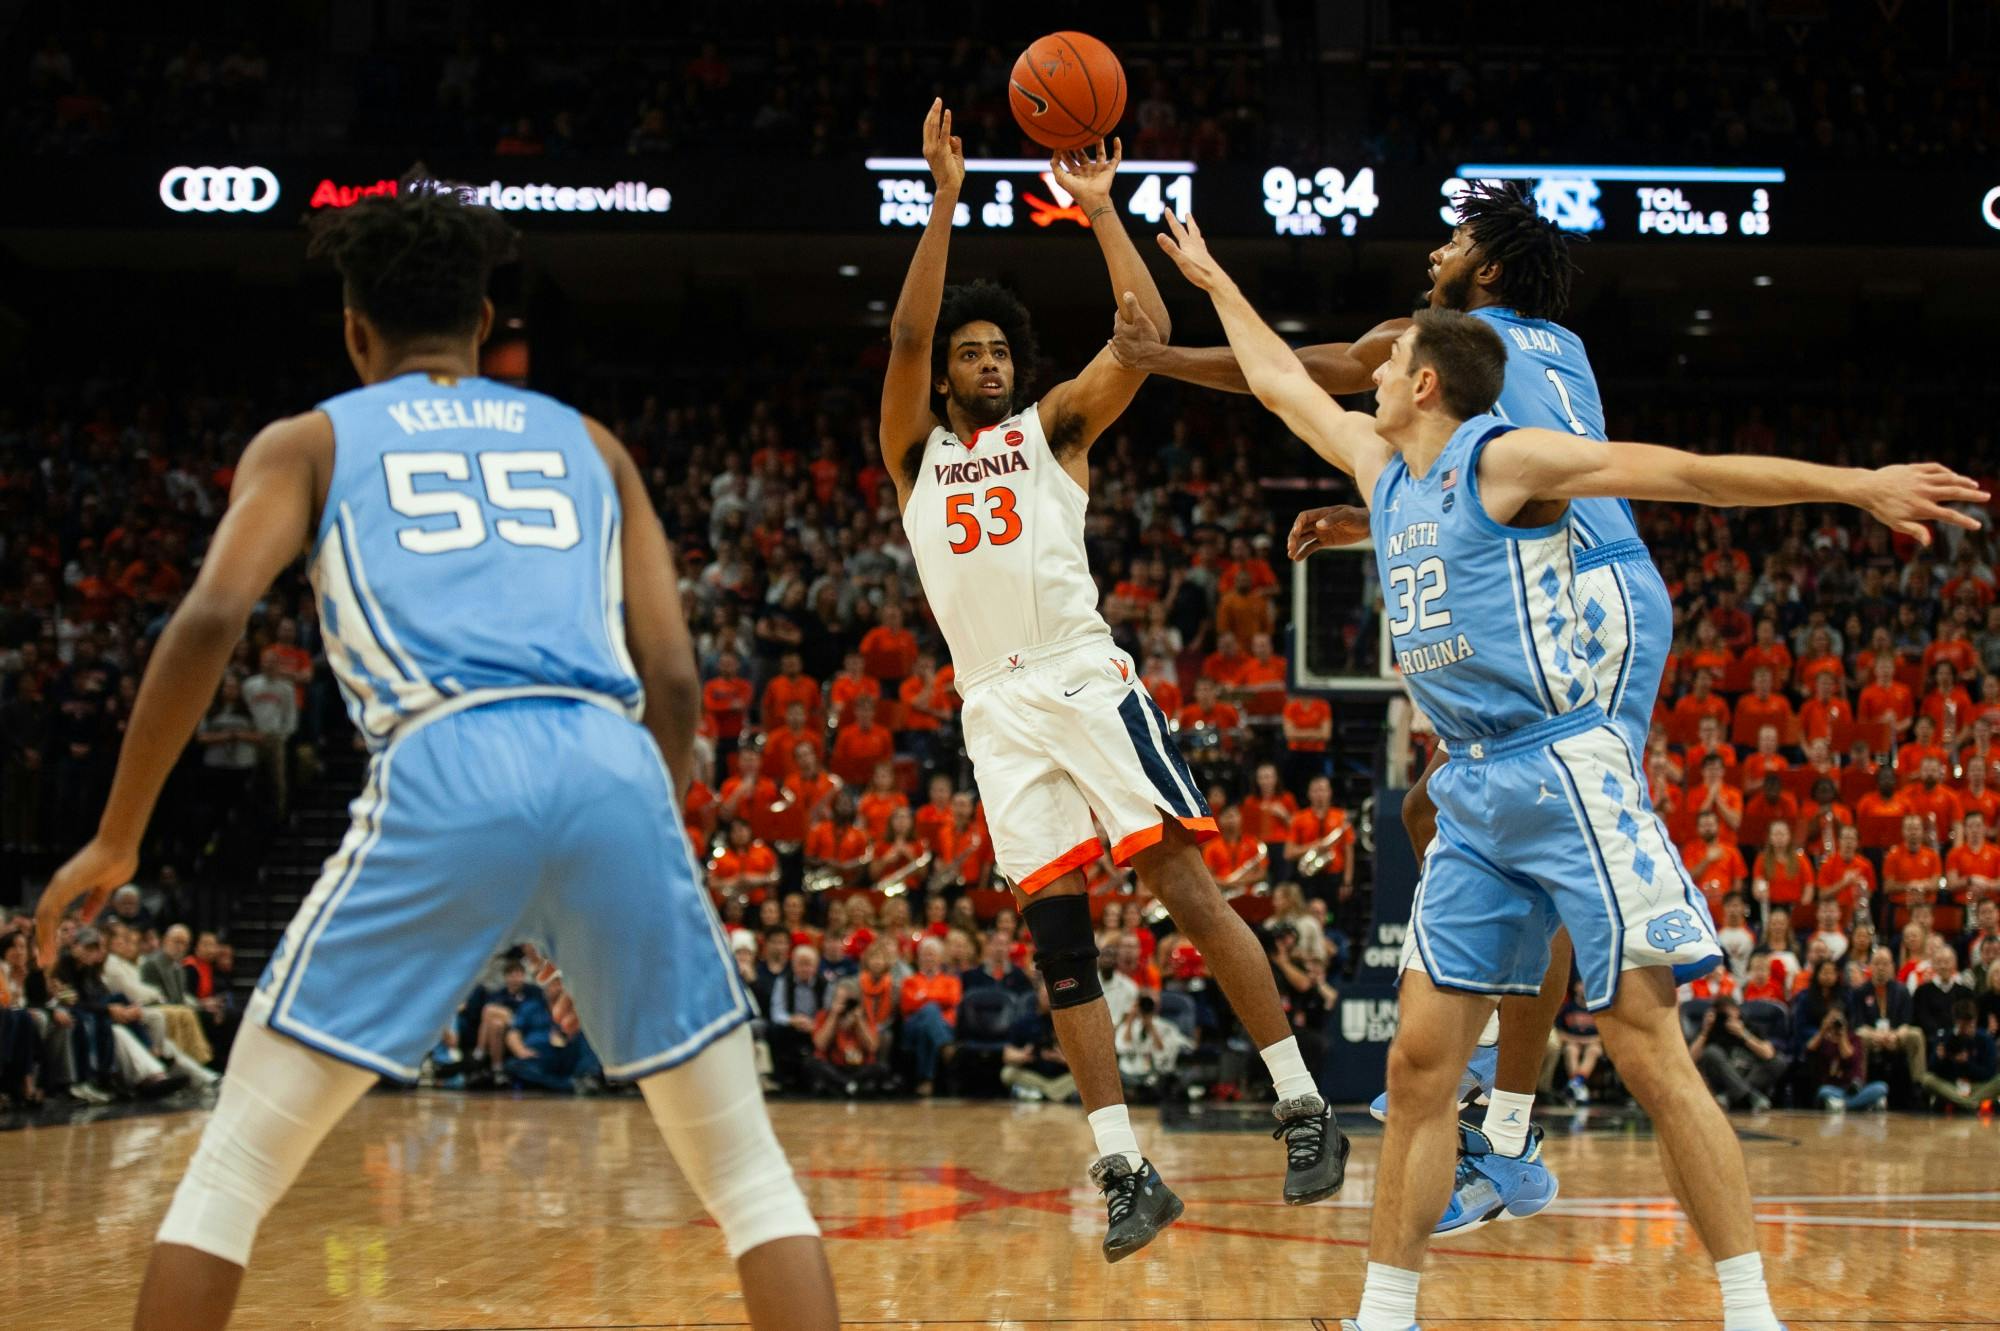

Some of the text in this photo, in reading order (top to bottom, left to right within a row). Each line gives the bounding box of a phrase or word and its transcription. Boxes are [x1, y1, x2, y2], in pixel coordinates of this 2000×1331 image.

[1129, 174, 1191, 223] 41
[1262, 166, 1379, 217] 9:34
[880, 202, 971, 227] FOUS
[1639, 211, 1728, 235] FOULS
[1508, 327, 1562, 355] BLACK
[388, 399, 527, 435] KEELING
[1545, 368, 1587, 435] 1
[934, 450, 1030, 486] VIRGINIA
[381, 451, 582, 555] 55
[945, 486, 1022, 554] 53
[1387, 521, 1439, 559] NRTH
[1389, 555, 1451, 637] 32
[1400, 633, 1475, 675] ROLINA
